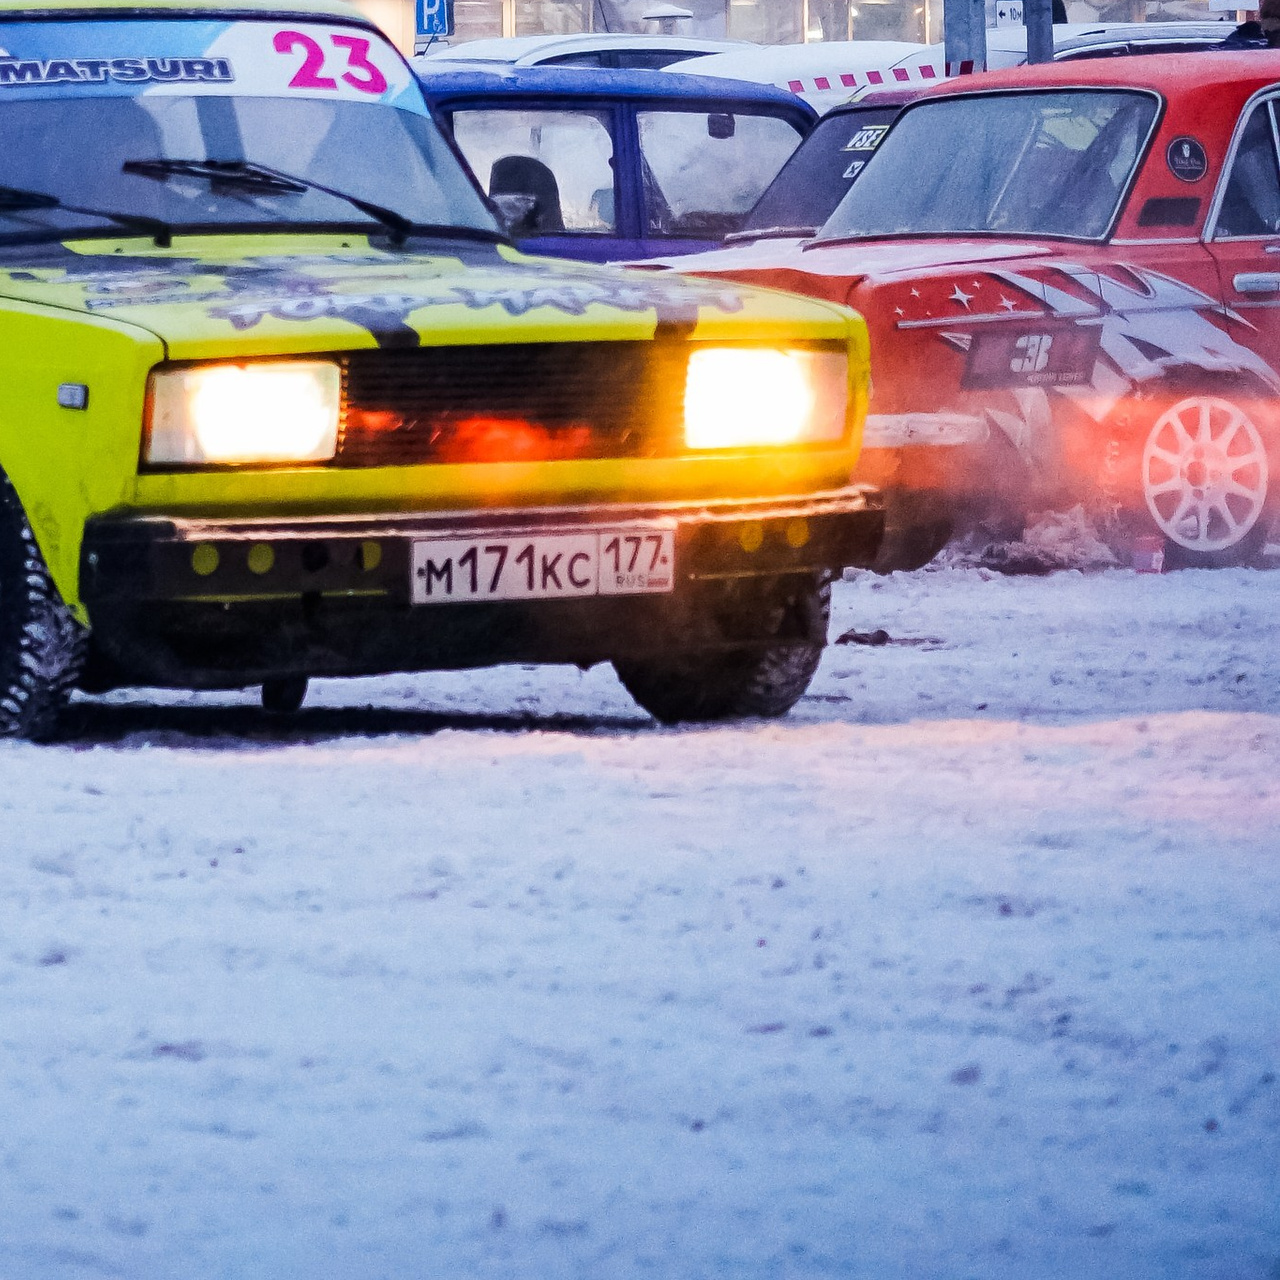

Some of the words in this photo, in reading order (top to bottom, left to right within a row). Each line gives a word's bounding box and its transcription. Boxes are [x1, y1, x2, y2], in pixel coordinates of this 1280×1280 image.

[272, 30, 388, 94] 23
[605, 534, 663, 573] 177
[616, 574, 646, 588] RUS
